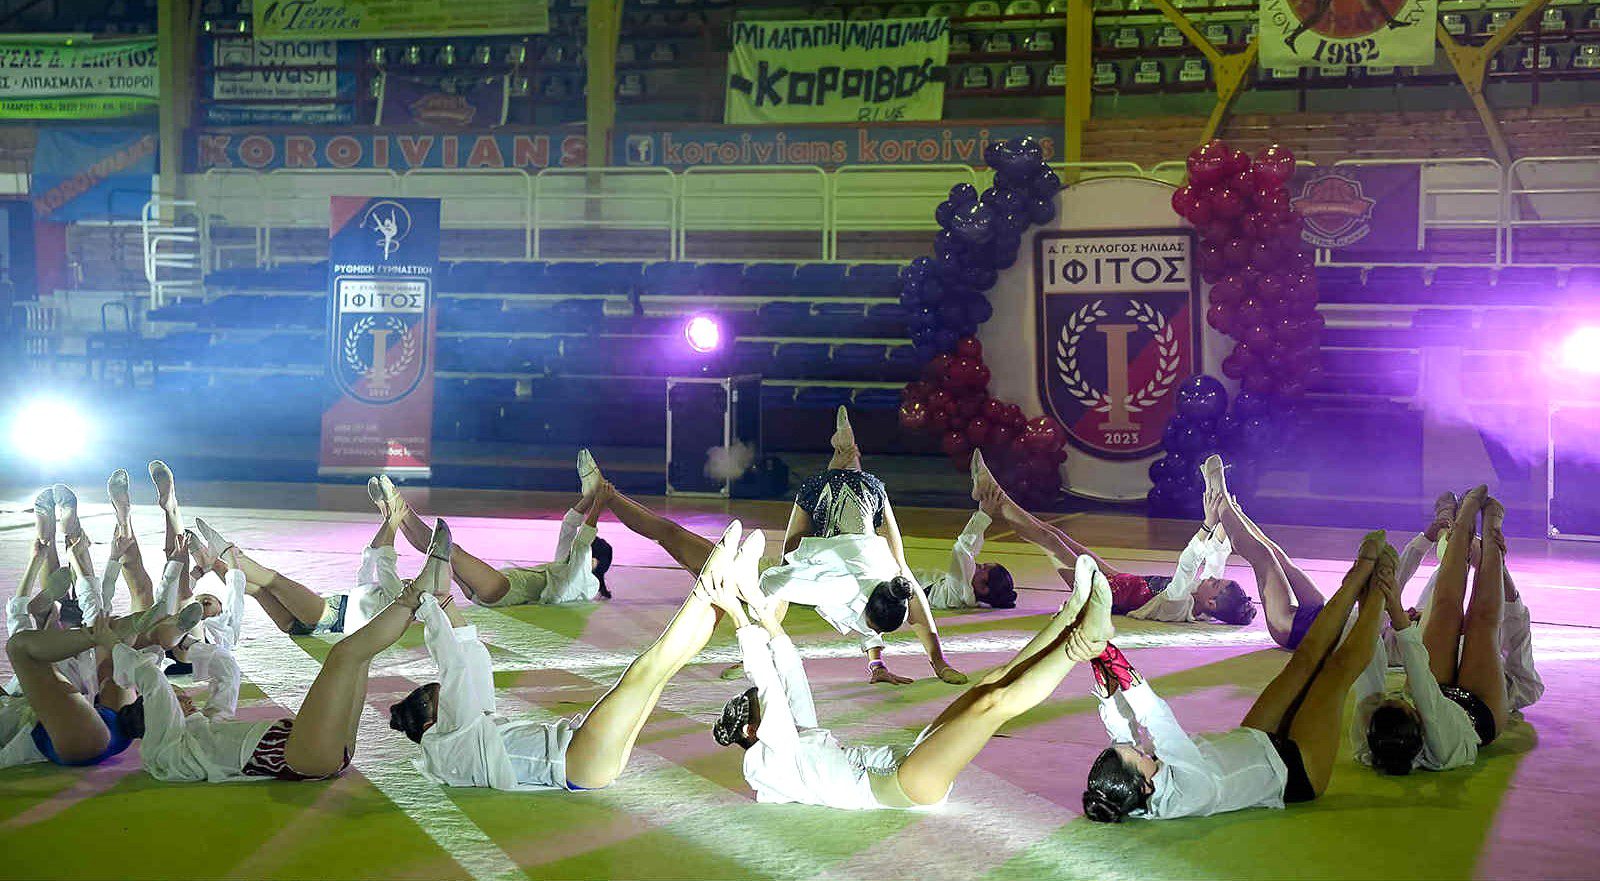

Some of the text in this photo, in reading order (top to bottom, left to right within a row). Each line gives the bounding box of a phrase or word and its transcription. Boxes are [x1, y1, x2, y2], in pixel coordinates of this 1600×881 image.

[259, 40, 332, 59] Smart
[1312, 38, 1380, 65] 1982
[21, 75, 94, 90] ΛΙΠΑΣΜΑΤΑ
[108, 74, 153, 89] ΣΠΟΡΟΙ
[260, 61, 332, 84] Wash
[197, 134, 589, 168] KOROIVIANS
[663, 132, 847, 164] koroivians
[857, 129, 1055, 164] koroivis
[1075, 243, 1138, 254] ΣΥΛΛΟΓΟΣ
[1141, 242, 1185, 252] ΗΛΙΔΑΣ
[334, 264, 433, 275] ΡΥΘΜΙΚΗ ΓΥΜΝΑΣΤΙΚΗ
[1049, 256, 1185, 285] ΙΦΙΤΟΣ
[344, 293, 421, 308] ΙΦΙΤΟΣ
[1104, 432, 1139, 445] 2023
